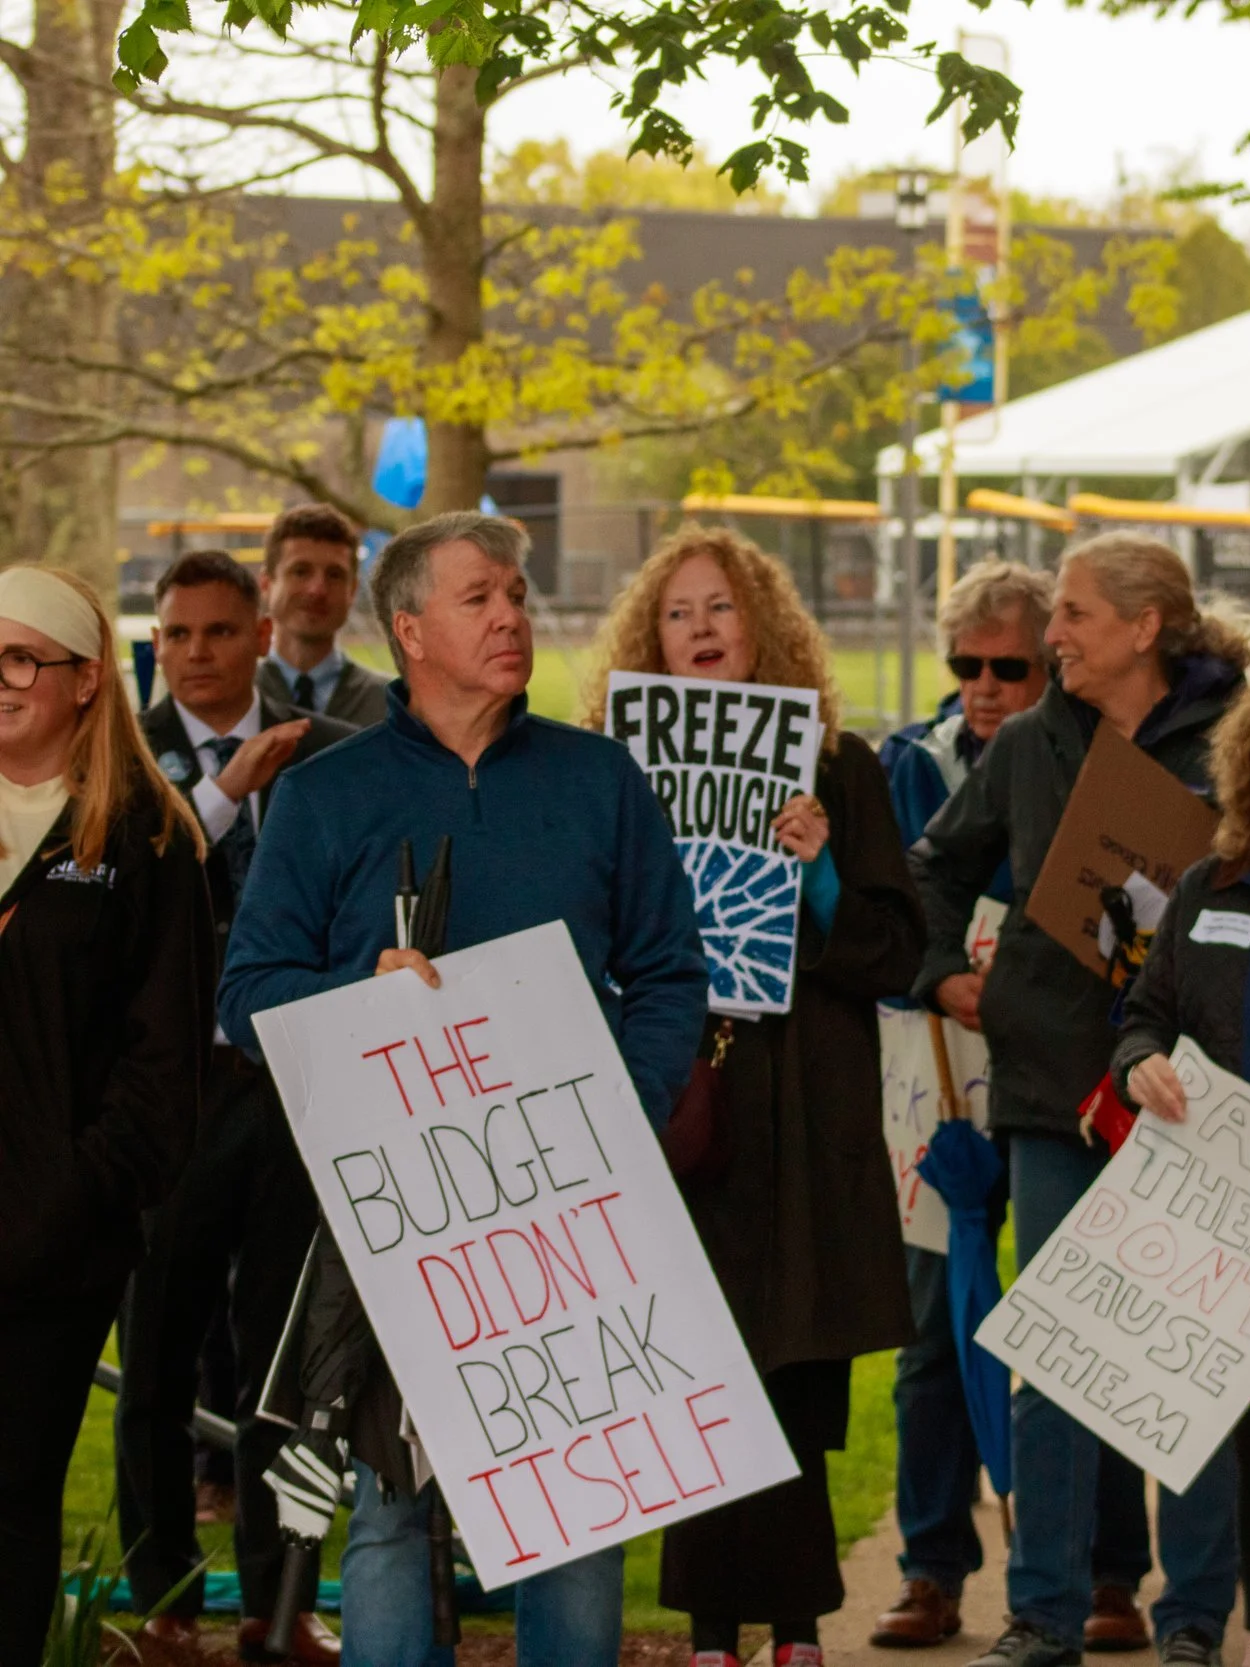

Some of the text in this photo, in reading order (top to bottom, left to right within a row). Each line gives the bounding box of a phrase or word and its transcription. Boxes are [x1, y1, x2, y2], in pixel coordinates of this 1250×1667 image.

[612, 684, 811, 782] FREEZE
[646, 769, 805, 857] RLOUGH
[361, 1015, 513, 1117] THE
[332, 1072, 613, 1255] BUDGET
[417, 1191, 638, 1352] DIDN'T
[1035, 1235, 1245, 1399] PAUSE
[456, 1293, 696, 1459] BREAK
[1001, 1289, 1190, 1455] THEM
[467, 1384, 731, 1567] ITSELF
